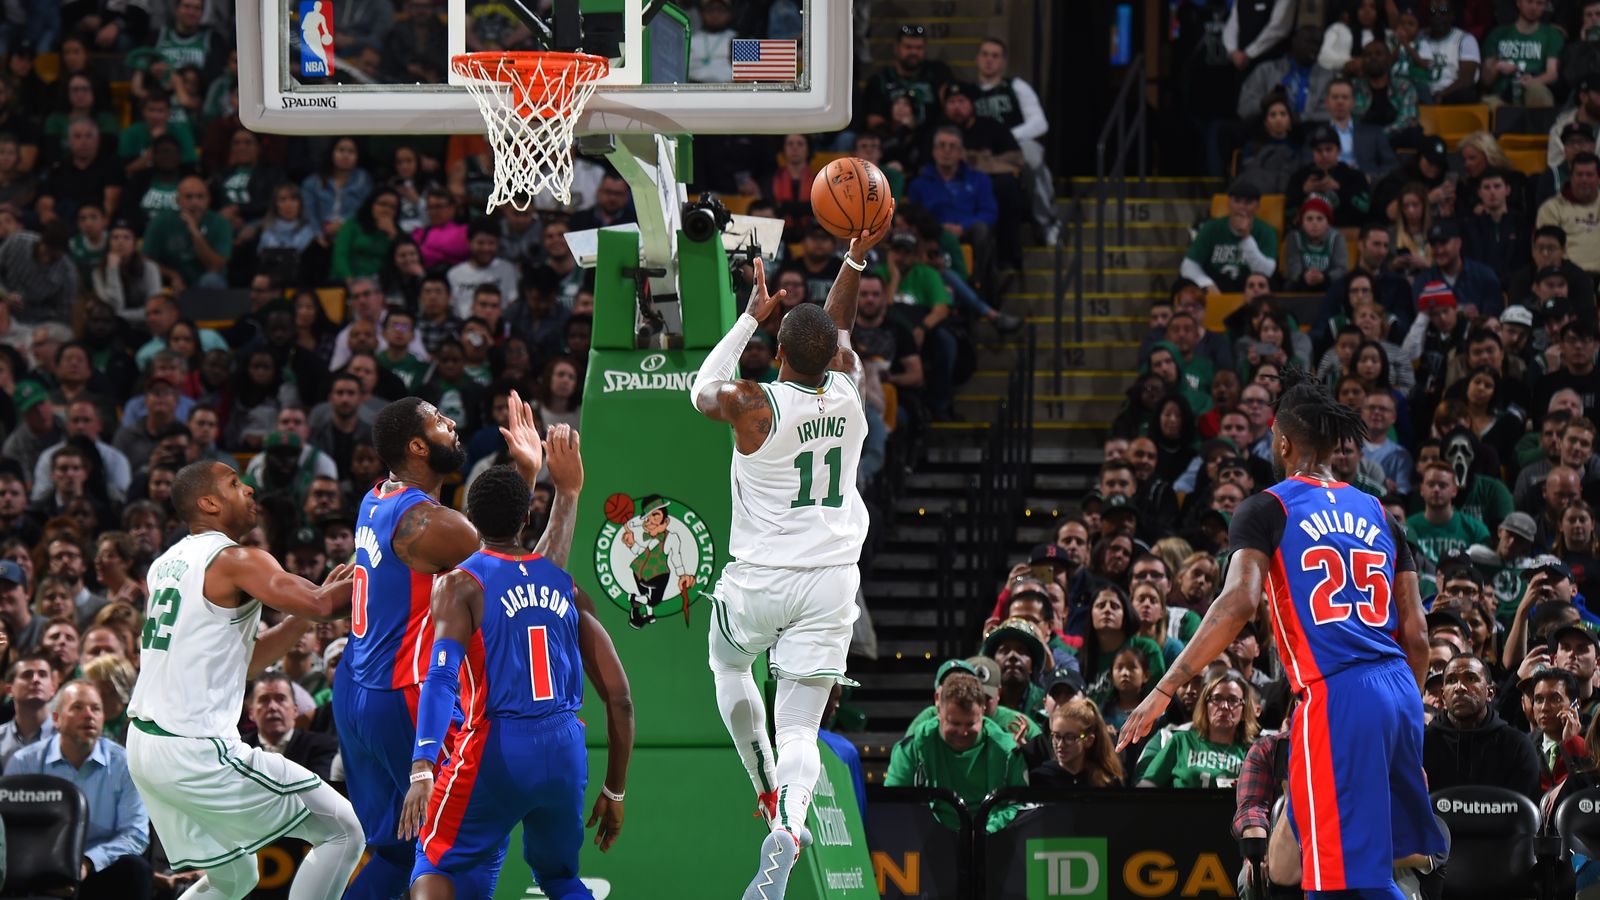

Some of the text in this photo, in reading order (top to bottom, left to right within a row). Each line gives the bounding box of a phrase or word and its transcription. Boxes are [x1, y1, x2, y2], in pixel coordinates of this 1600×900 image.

[305, 61, 324, 72] NBA
[281, 96, 337, 109] SPALDING
[860, 158, 878, 202] ALDING
[1129, 204, 1150, 221] 15
[1088, 299, 1110, 316] 13
[797, 416, 847, 444] IRVING
[790, 446, 844, 509] 11
[1300, 510, 1381, 546] BULLOCK
[596, 524, 622, 599] BOSTON
[683, 511, 714, 586] CELTICS
[351, 564, 369, 638] 0
[500, 583, 570, 619] JACKSON
[1300, 545, 1391, 627] 25
[141, 587, 182, 652] 42
[527, 625, 554, 702] 1
[0, 789, 62, 802] Putnam
[1452, 802, 1518, 814] Putnam
[1034, 852, 1100, 896] TD
